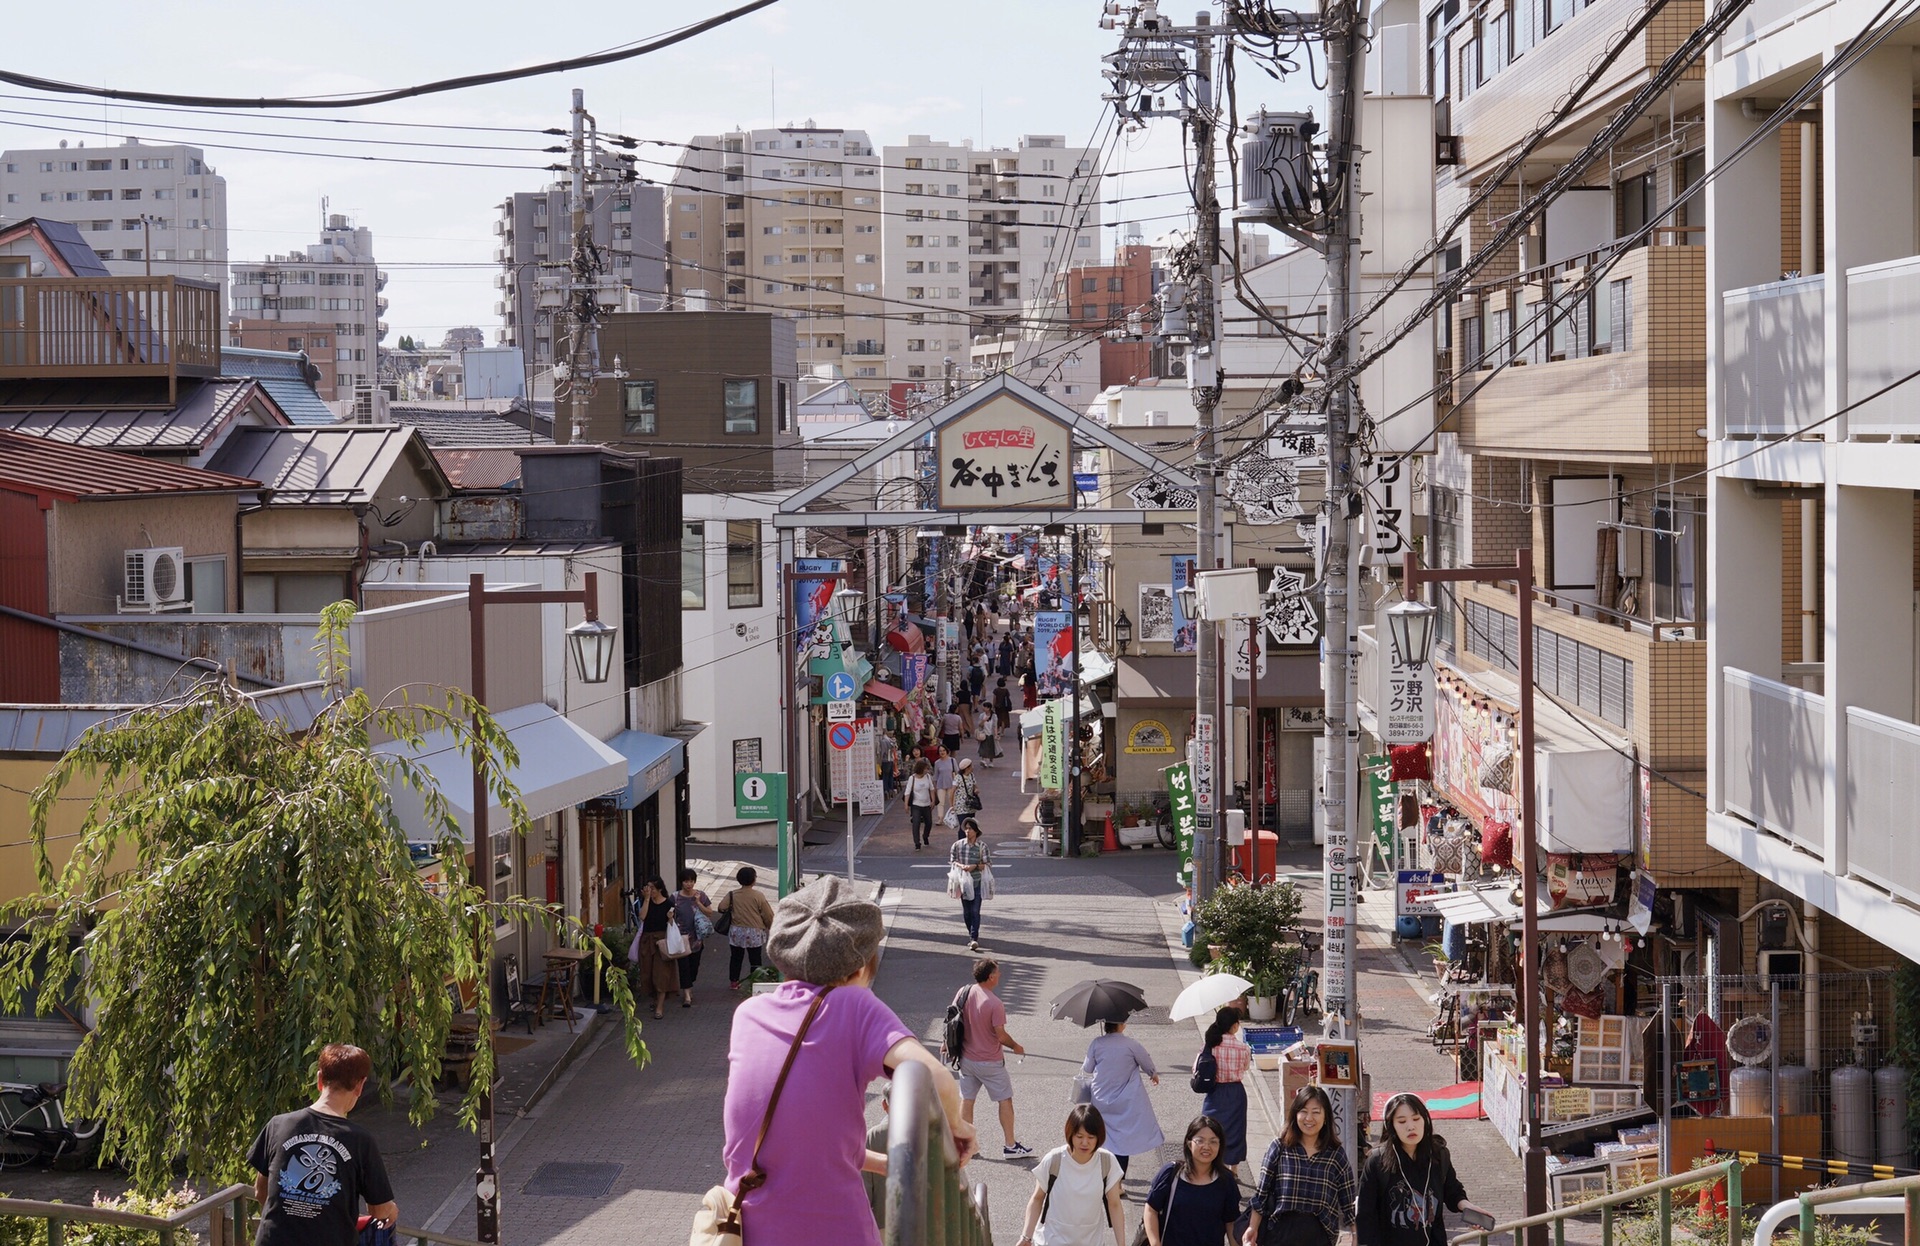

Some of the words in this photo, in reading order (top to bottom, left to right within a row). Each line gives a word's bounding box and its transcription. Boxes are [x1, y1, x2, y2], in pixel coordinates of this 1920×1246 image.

[964, 425, 1035, 449] ひぐらしの里
[949, 443, 1061, 498] 谷中ぎんざ
[1171, 770, 1195, 836] 竹工芸
